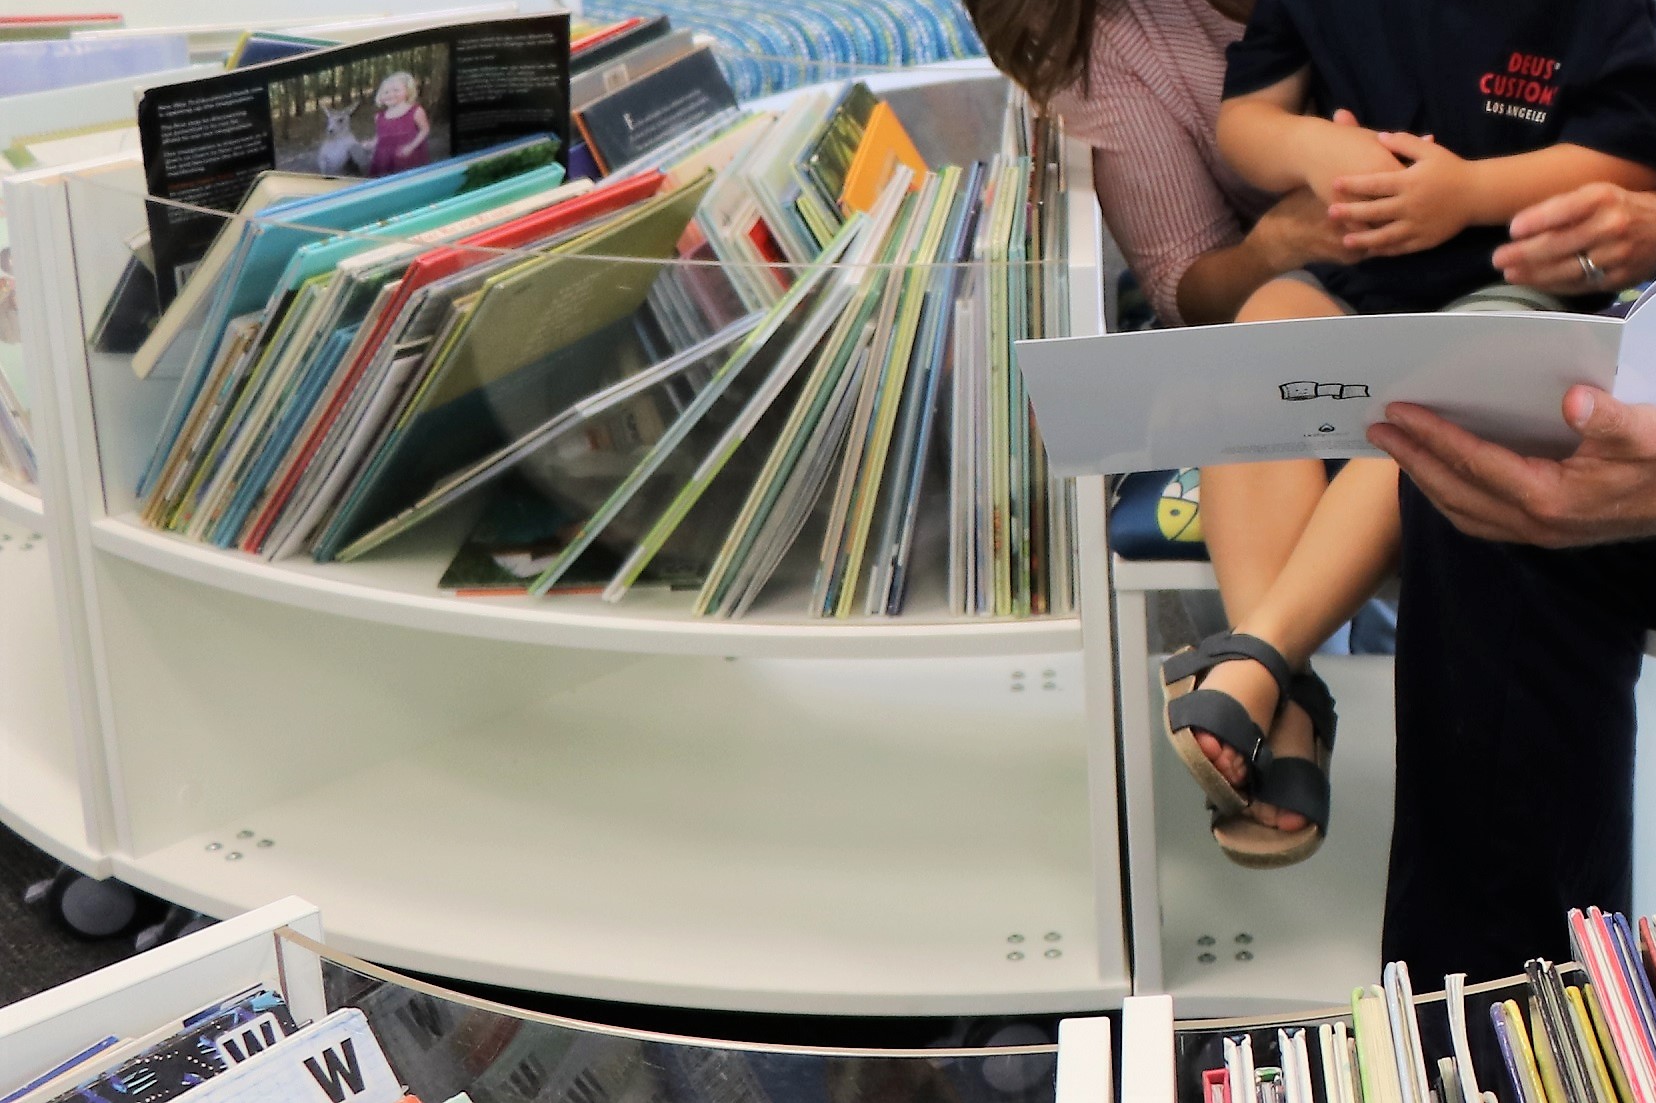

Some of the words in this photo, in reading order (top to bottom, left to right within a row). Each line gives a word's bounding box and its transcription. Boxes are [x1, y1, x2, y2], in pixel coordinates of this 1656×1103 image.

[1479, 73, 1558, 105] CUSTOM
[1485, 100, 1504, 114] LOS
[1506, 104, 1547, 124] ANGELES
[303, 1037, 366, 1103] W
